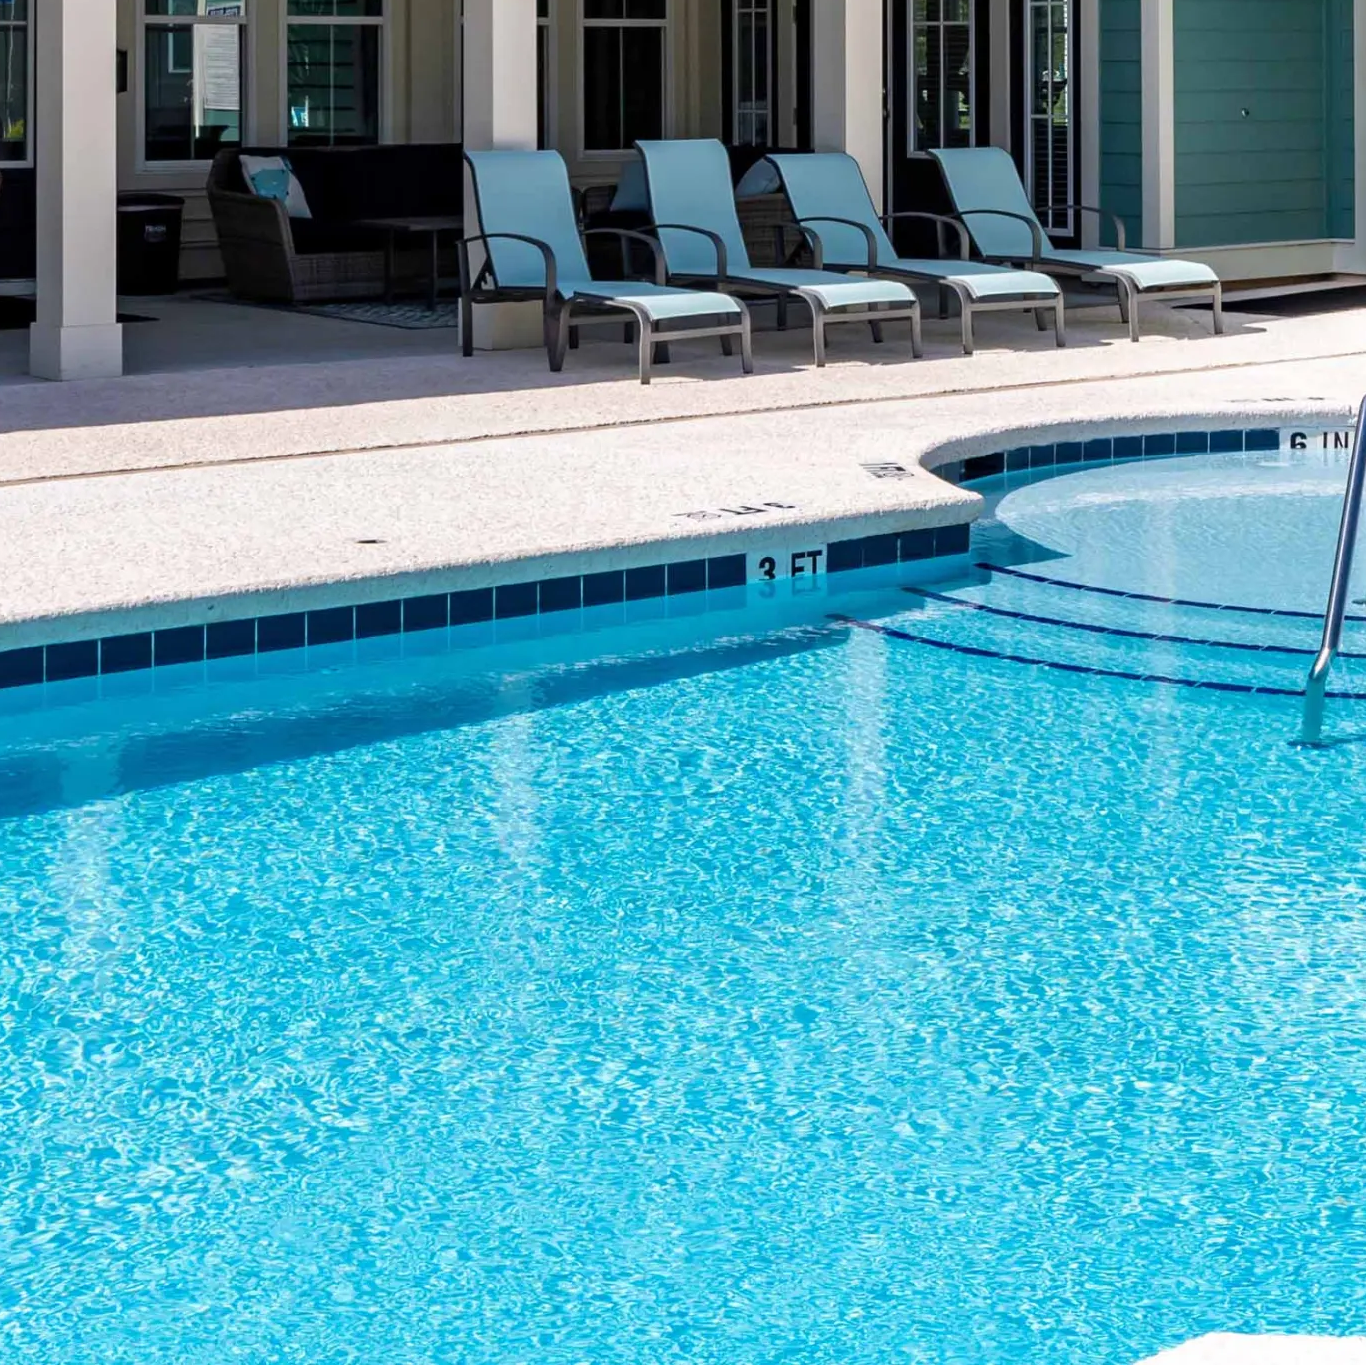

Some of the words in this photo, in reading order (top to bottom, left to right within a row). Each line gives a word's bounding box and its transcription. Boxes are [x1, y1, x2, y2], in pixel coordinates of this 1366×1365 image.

[1290, 432, 1307, 449] 6
[1323, 431, 1349, 449] IN
[758, 556, 776, 580] 3
[791, 549, 823, 578] FT
